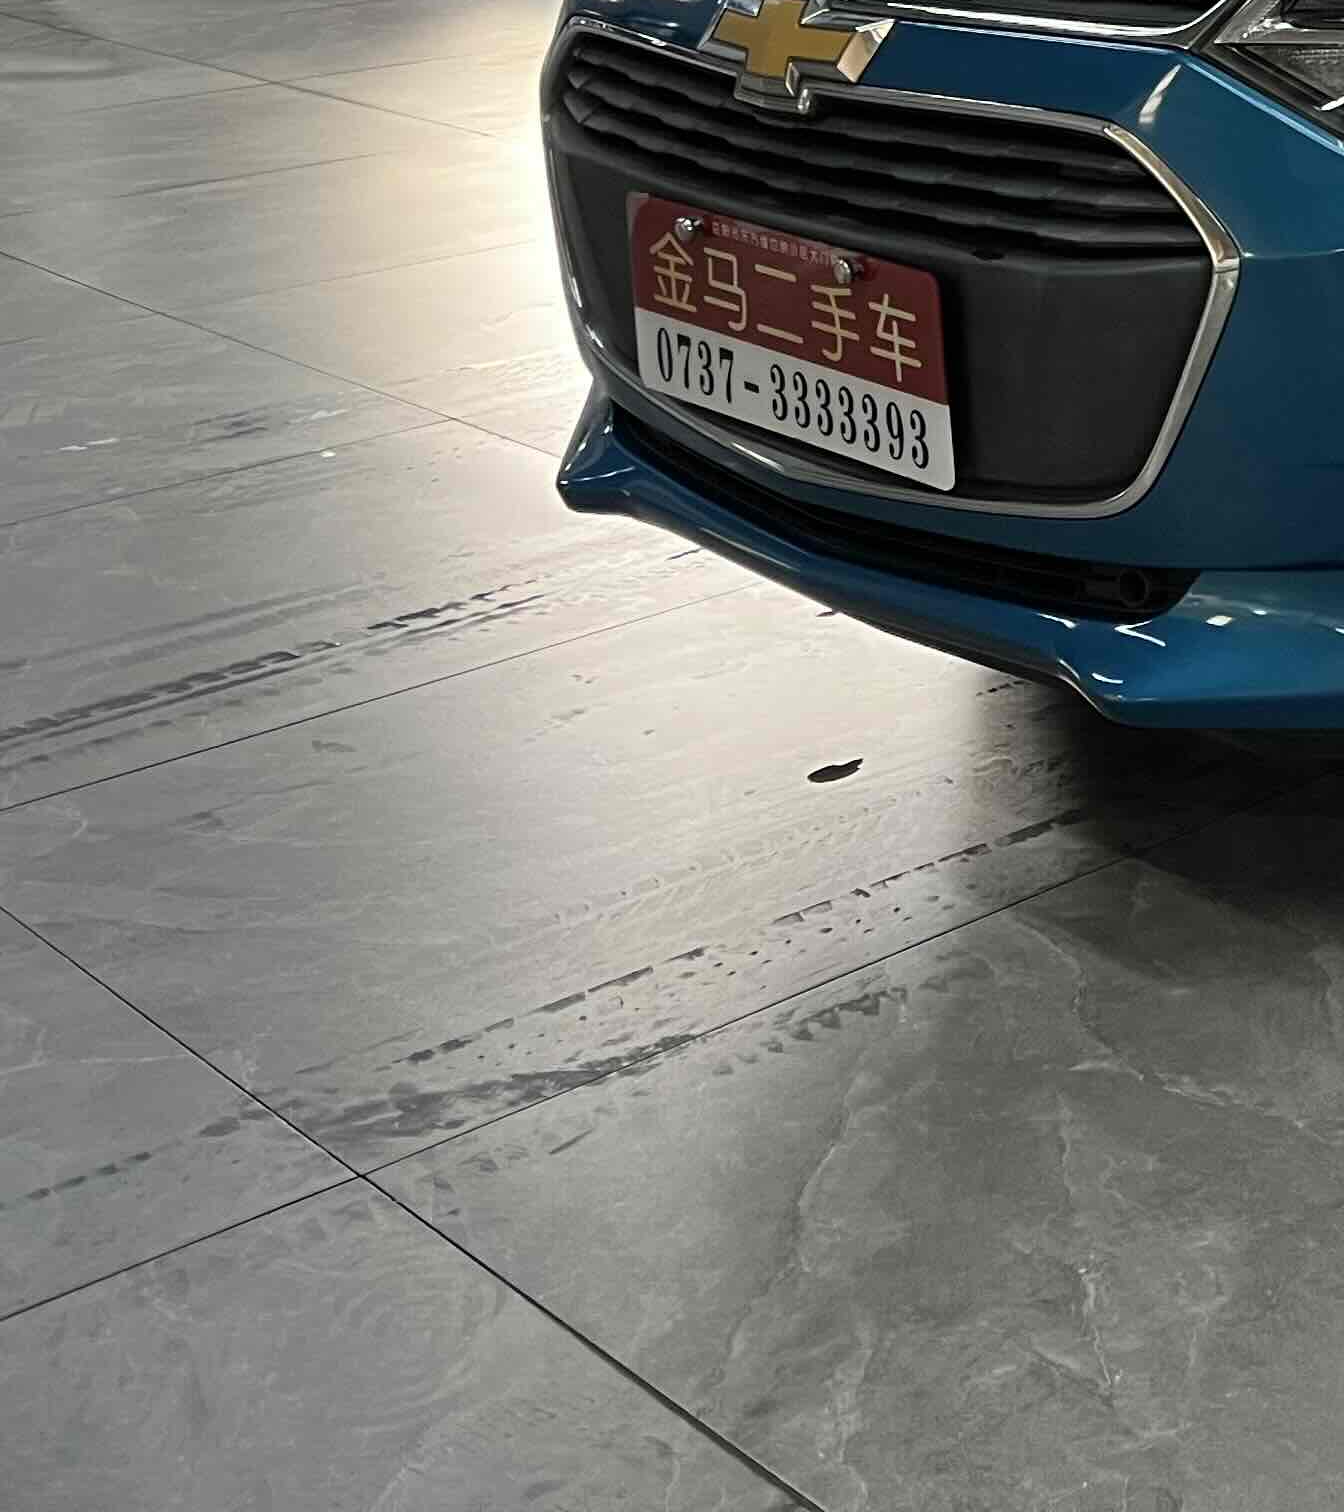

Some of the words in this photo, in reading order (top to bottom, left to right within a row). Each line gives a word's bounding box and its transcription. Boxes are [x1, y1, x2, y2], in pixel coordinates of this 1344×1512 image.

[649, 231, 923, 383] 金马二手车
[656, 327, 930, 469] 0737-3333393
